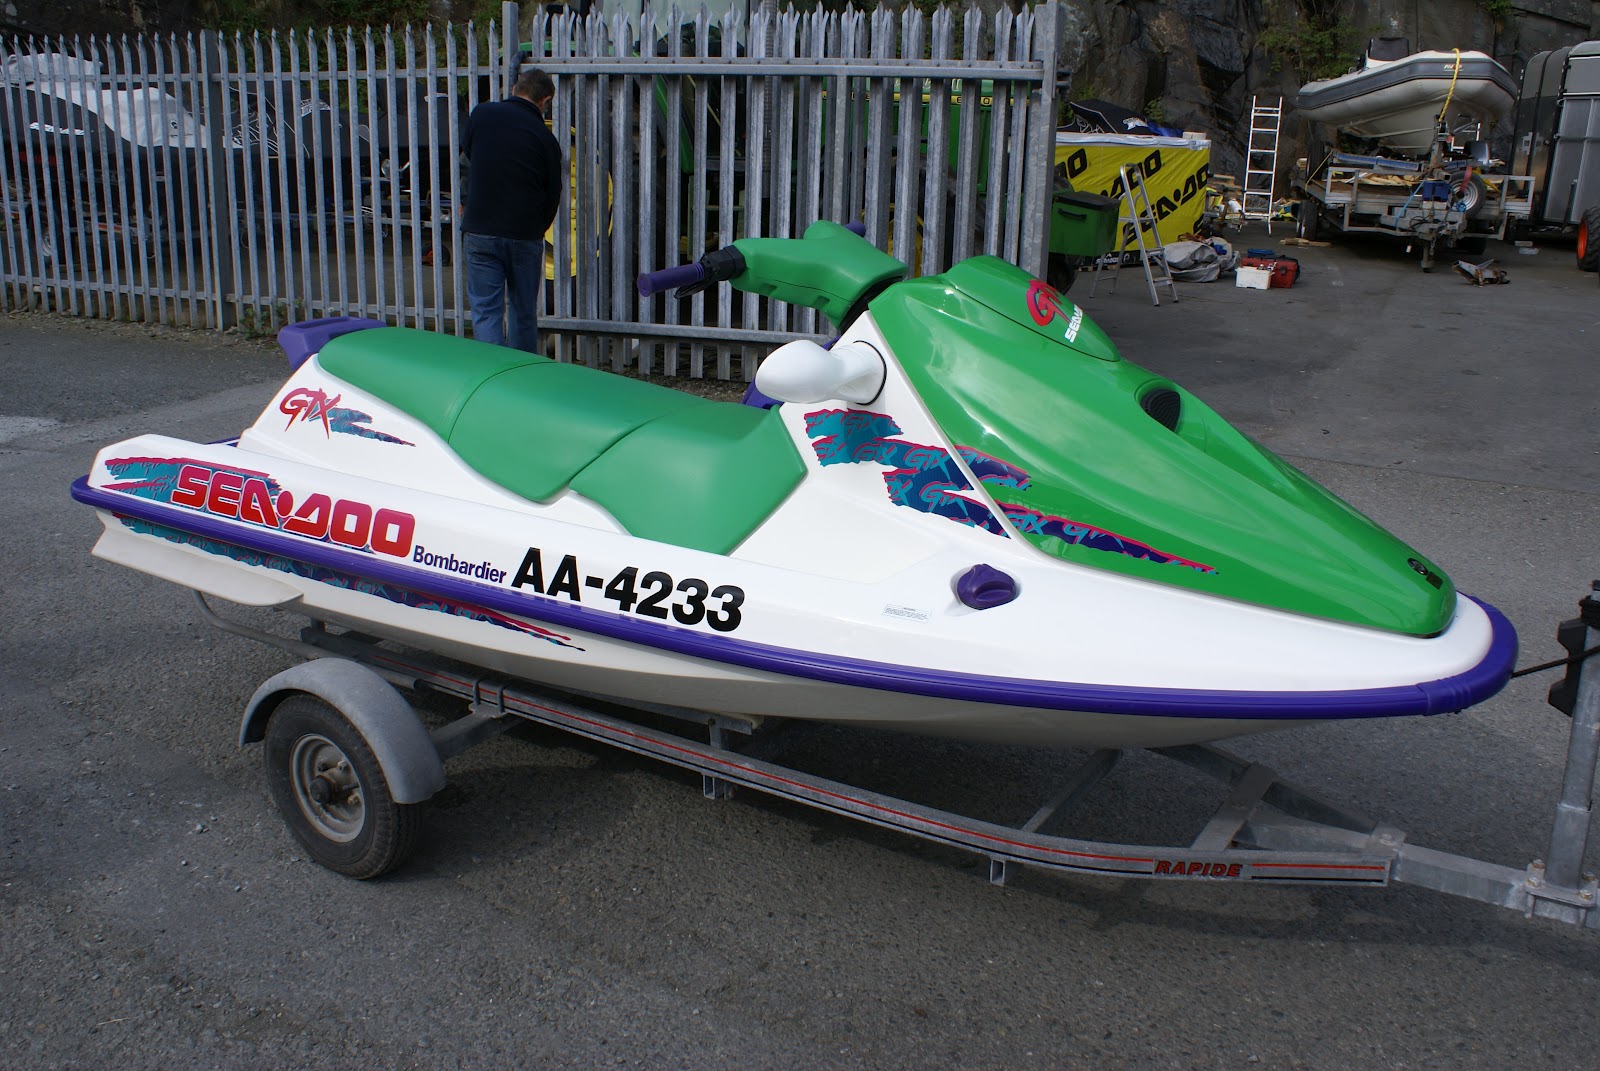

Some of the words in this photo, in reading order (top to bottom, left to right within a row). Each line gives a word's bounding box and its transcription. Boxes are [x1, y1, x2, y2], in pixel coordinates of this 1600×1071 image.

[279, 387, 342, 440] GTX
[413, 544, 507, 584] Bombardier
[511, 547, 746, 632] AA-4233
[1154, 860, 1243, 878] RAPIDE
